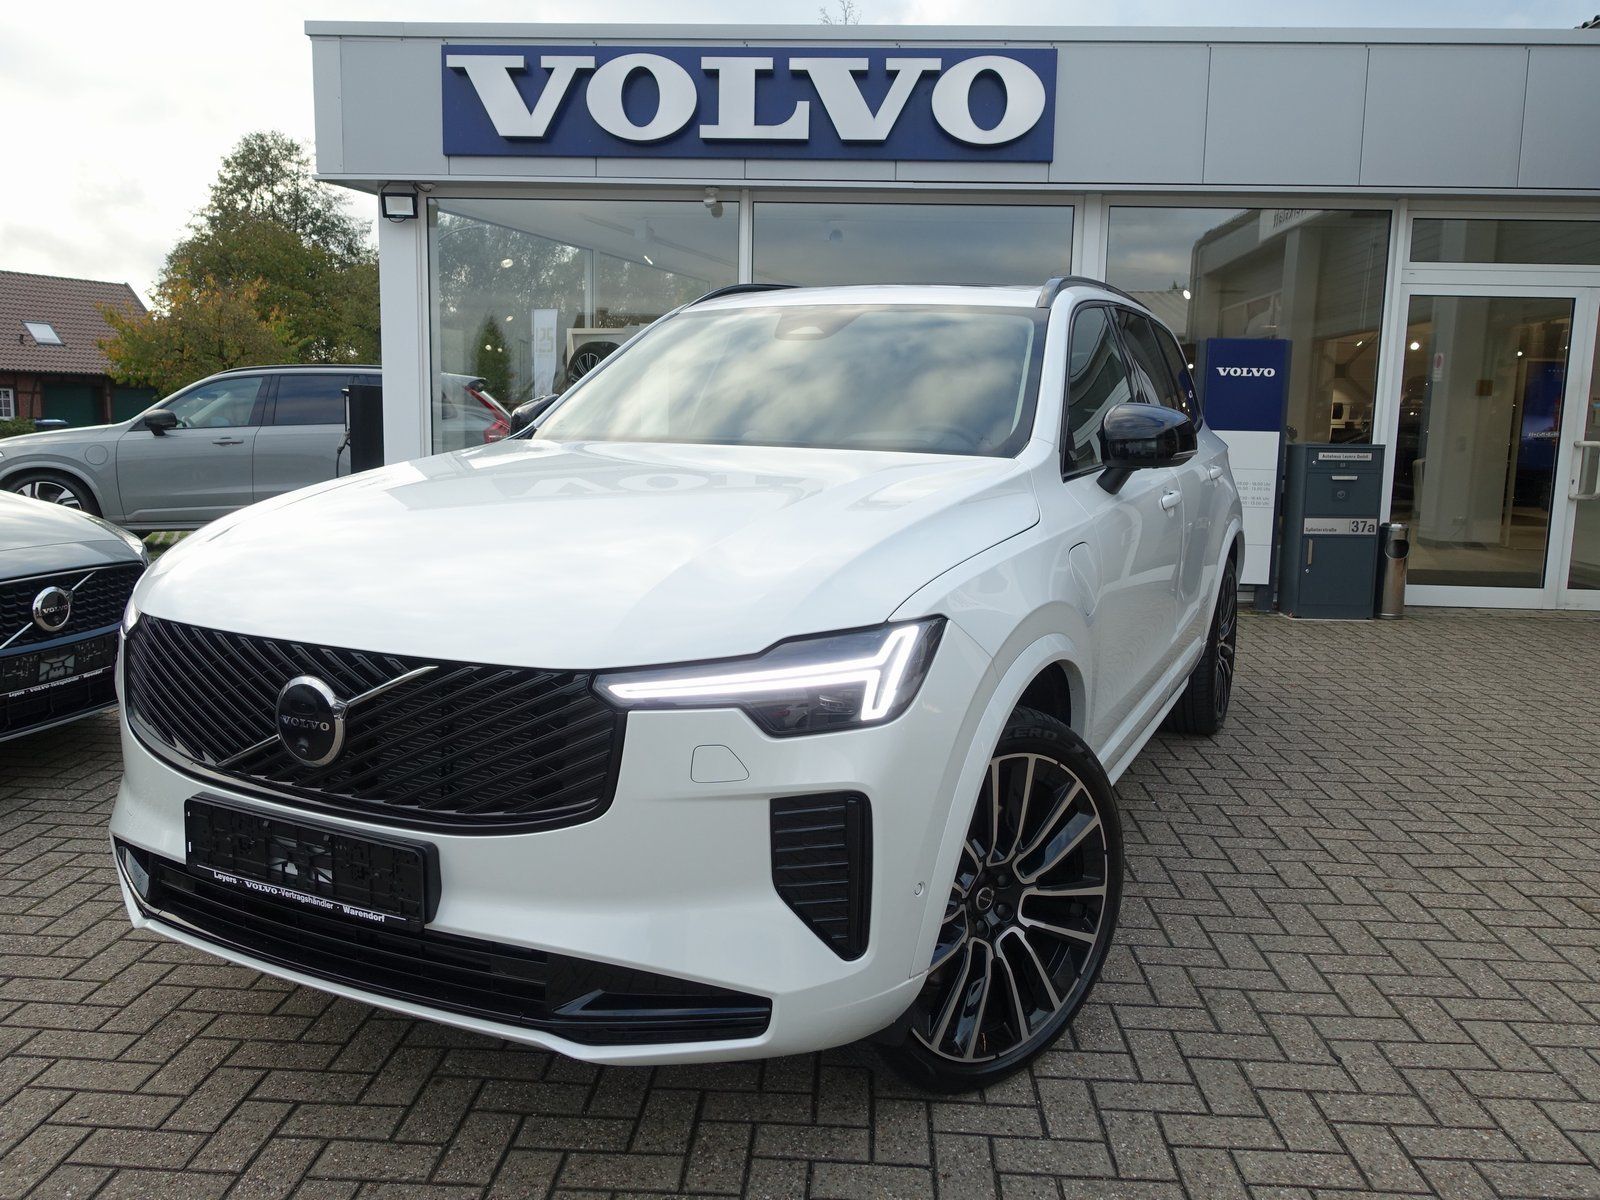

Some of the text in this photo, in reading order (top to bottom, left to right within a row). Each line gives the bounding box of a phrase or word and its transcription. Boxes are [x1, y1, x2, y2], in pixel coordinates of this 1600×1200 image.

[446, 52, 1047, 146] VOLVO
[1216, 367, 1276, 377] VOLVO
[1351, 520, 1375, 533] 37a
[280, 715, 330, 731] VOLVO
[213, 870, 238, 885] Leyers
[342, 904, 386, 923] Warendorf
